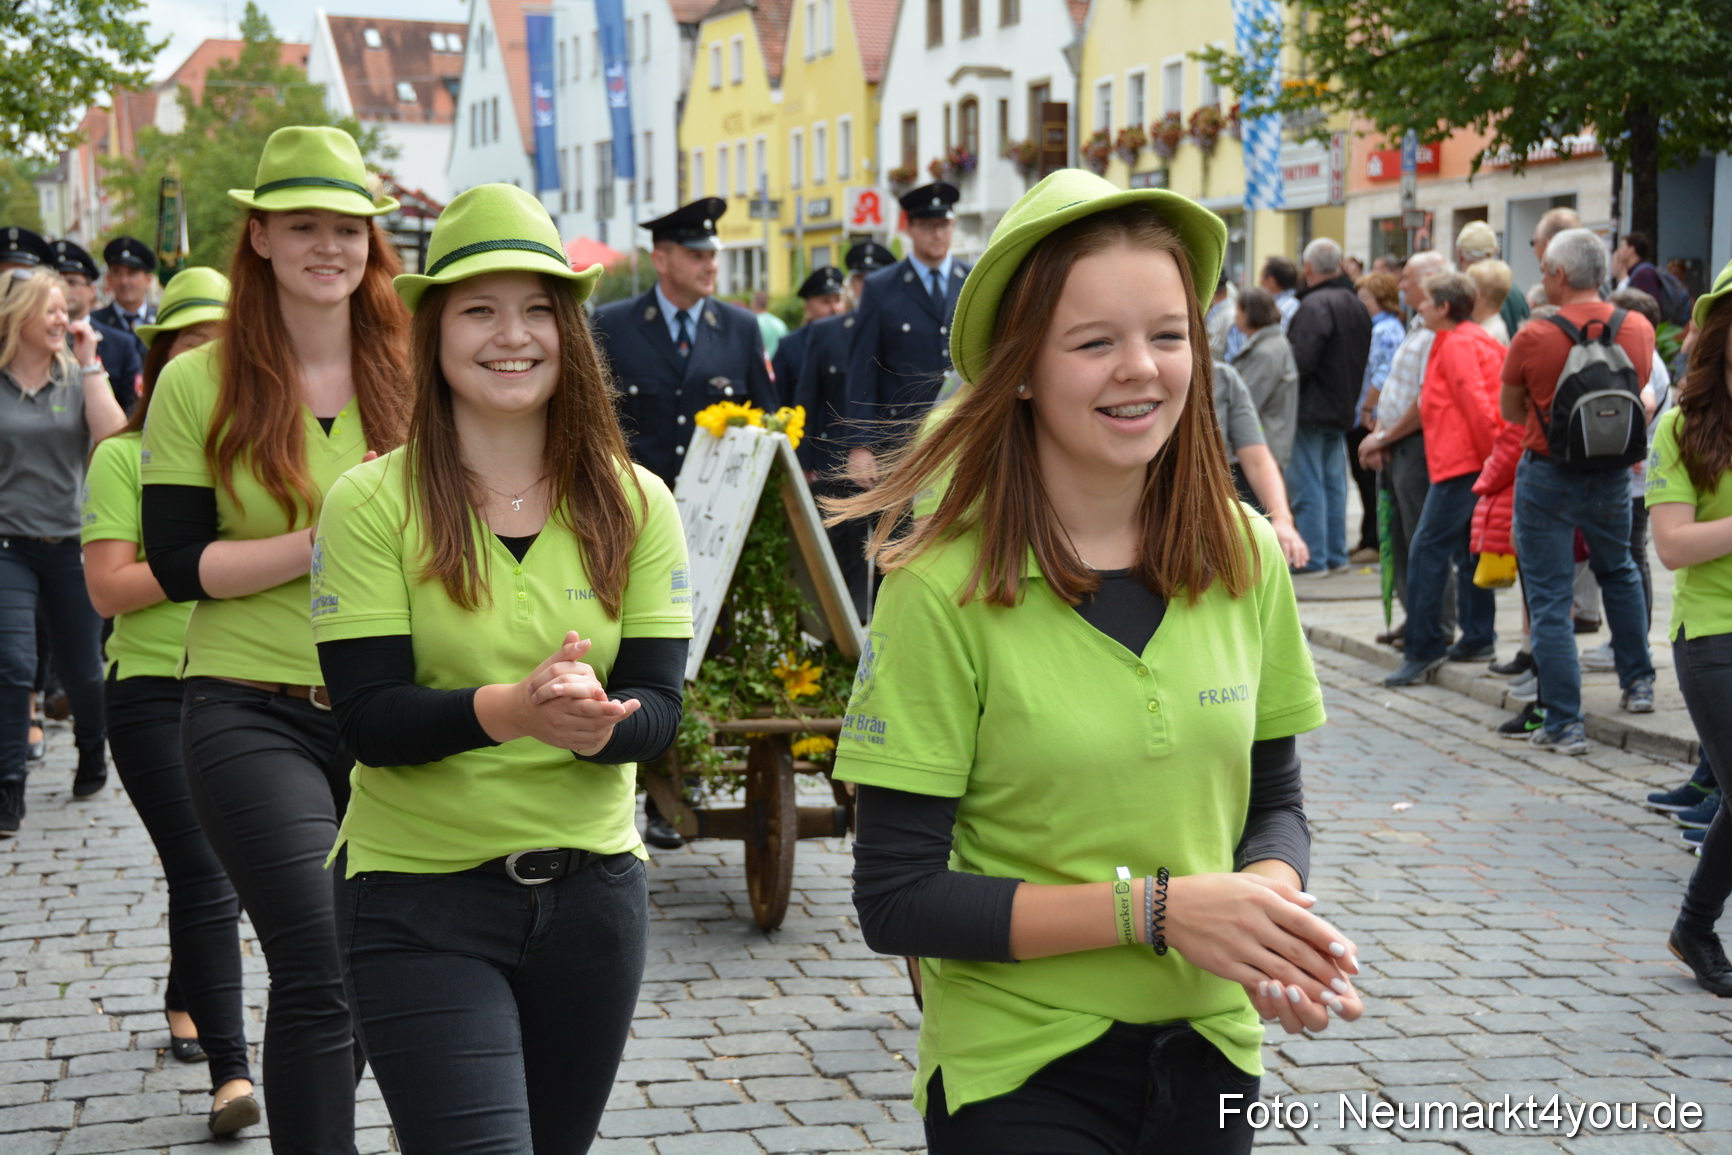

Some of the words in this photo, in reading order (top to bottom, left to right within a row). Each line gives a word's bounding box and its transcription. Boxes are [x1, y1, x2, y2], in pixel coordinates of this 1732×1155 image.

[565, 588, 597, 600] TINA
[1199, 685, 1249, 707] FRANZI
[857, 714, 886, 734] Bräu
